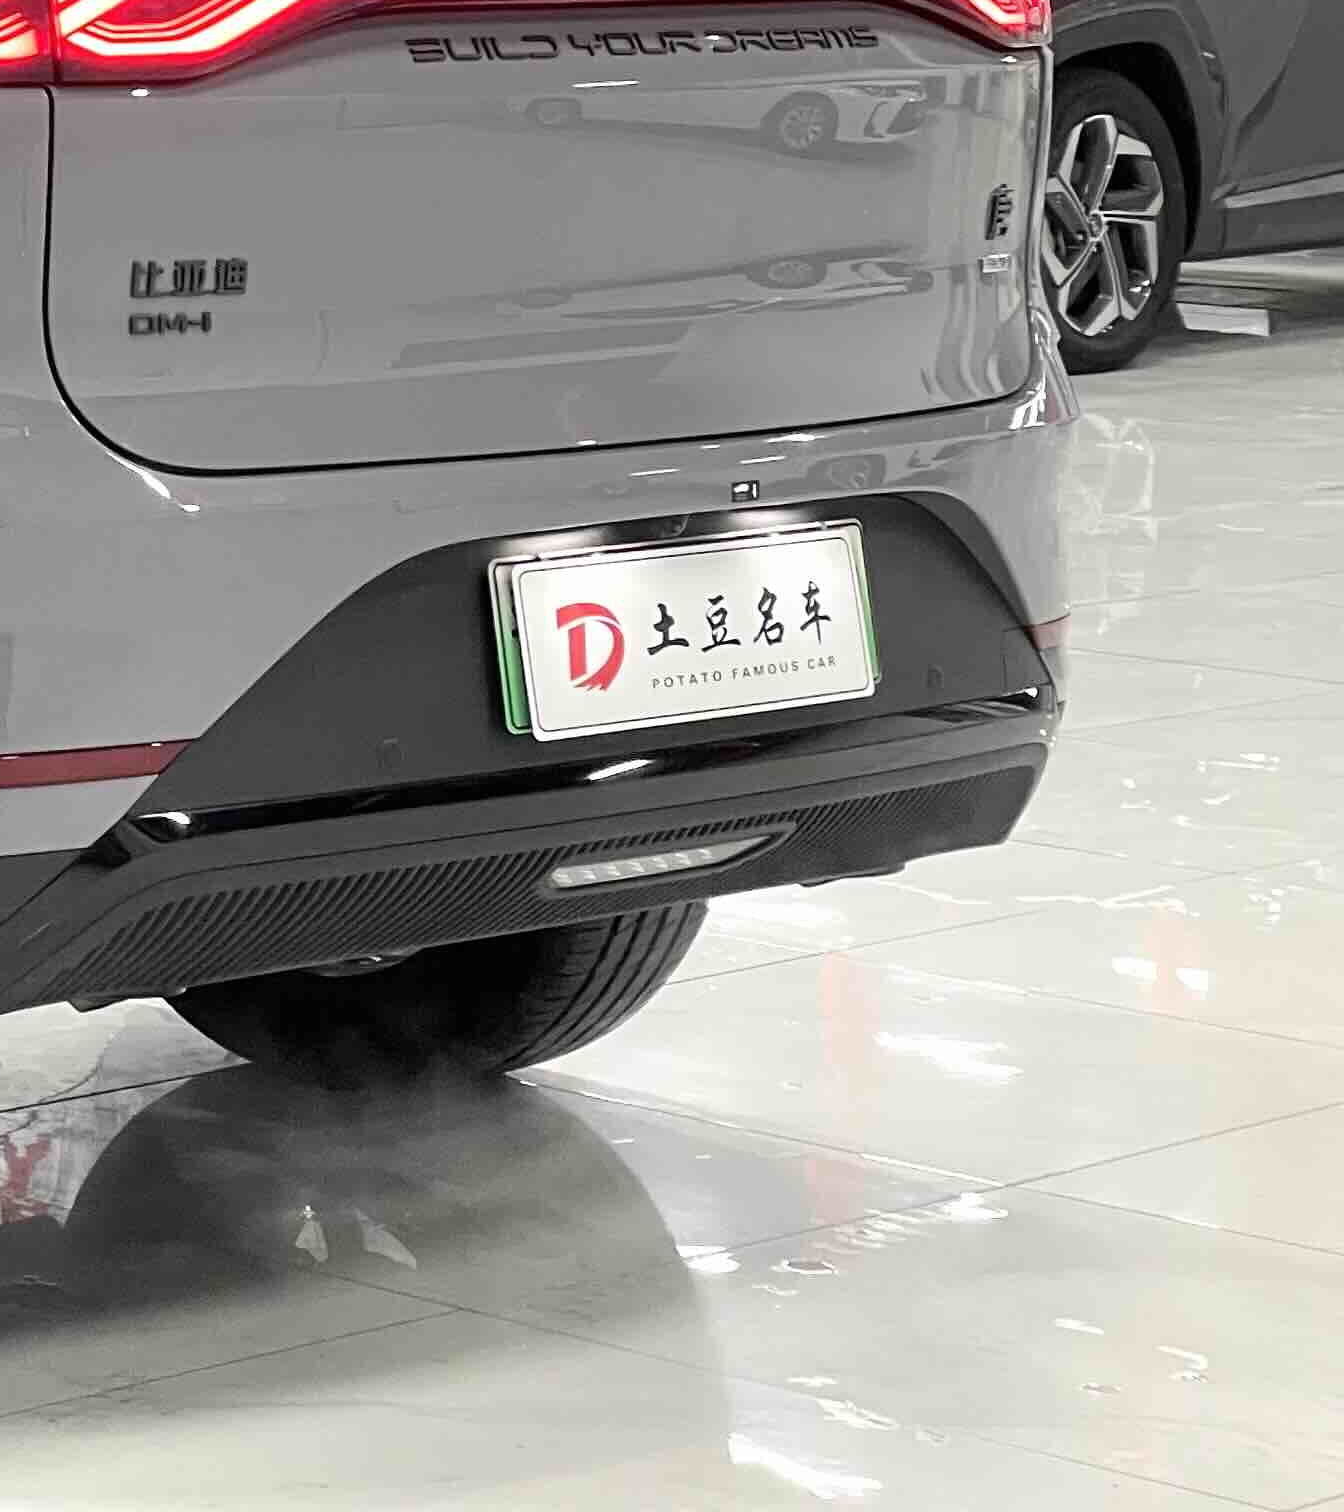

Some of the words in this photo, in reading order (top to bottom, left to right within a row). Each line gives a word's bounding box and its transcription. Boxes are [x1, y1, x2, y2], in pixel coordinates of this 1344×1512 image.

[406, 35, 558, 63] BUILD
[566, 31, 702, 56] YOUR
[705, 25, 880, 53] DREAMS
[130, 257, 247, 297] 比亚迪
[647, 580, 832, 656] 土豆名车
[651, 670, 723, 689] POTATO
[731, 660, 800, 681] FAMOUS
[807, 654, 838, 670] CAR
